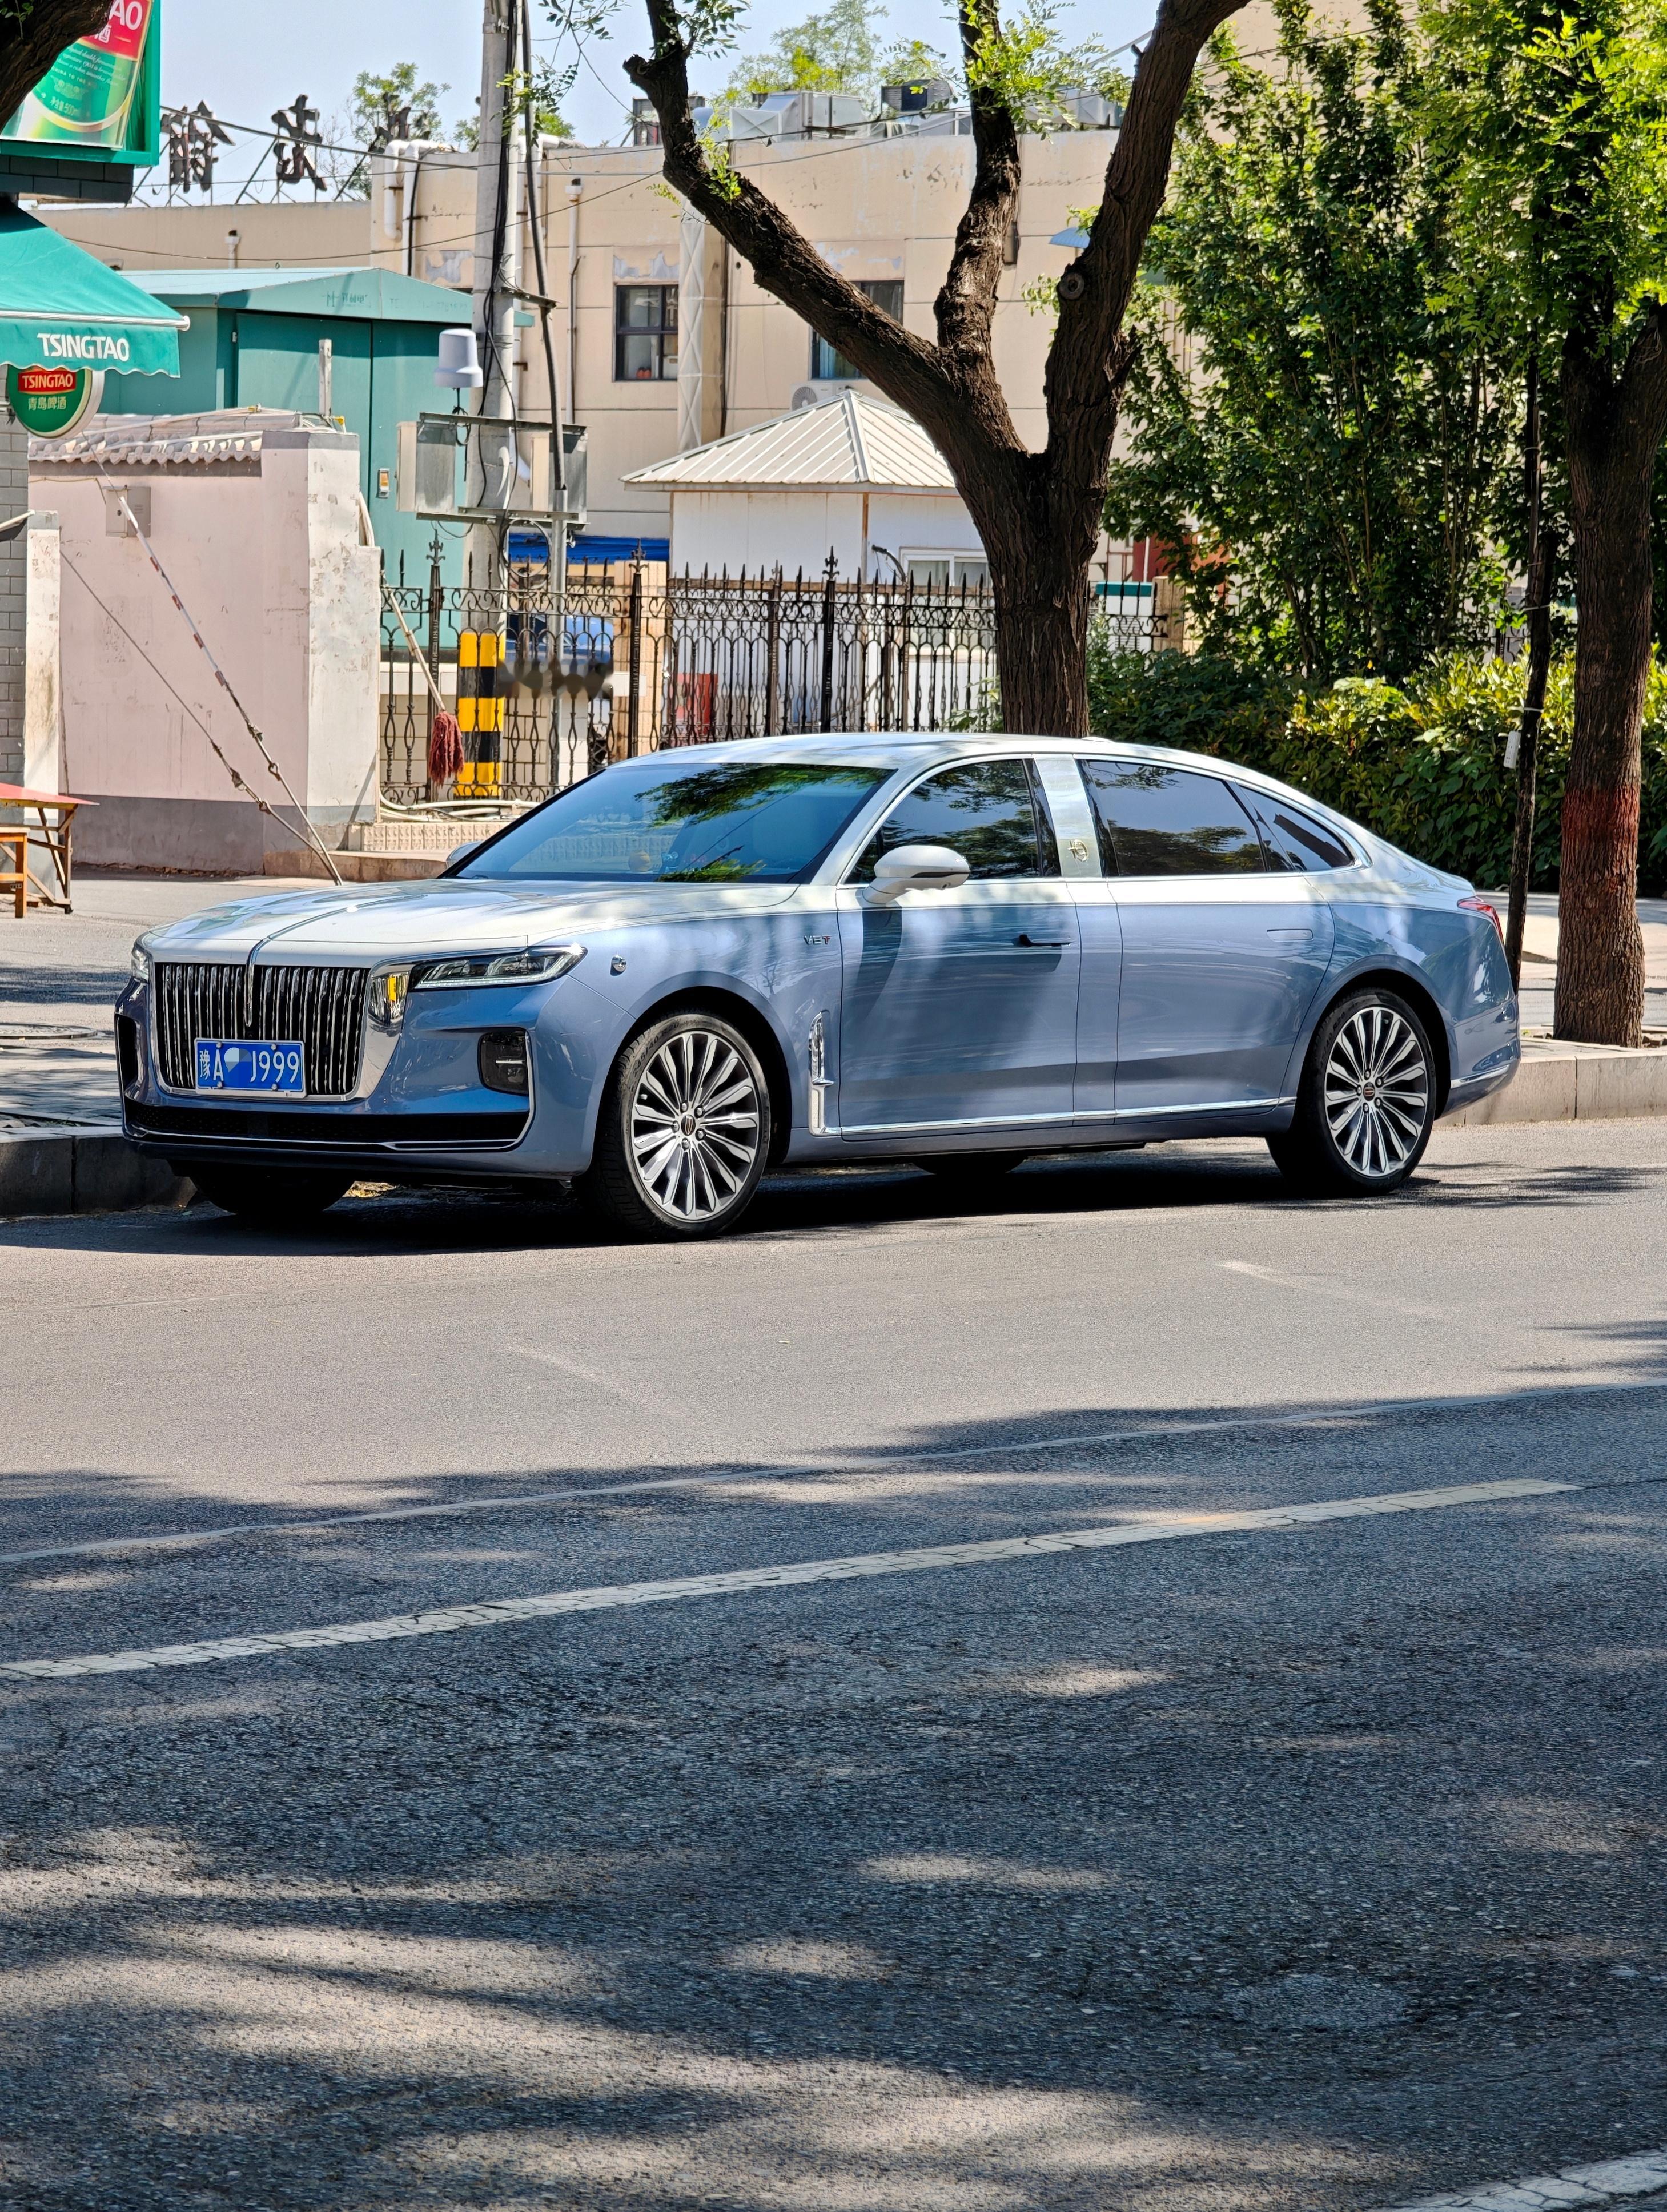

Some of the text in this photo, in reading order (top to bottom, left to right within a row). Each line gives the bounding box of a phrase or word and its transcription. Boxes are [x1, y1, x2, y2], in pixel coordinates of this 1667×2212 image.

[37, 333, 130, 361] TSINGTAO
[22, 373, 73, 388] TSINGTAO
[199, 1048, 299, 1083] 豫AJ999
